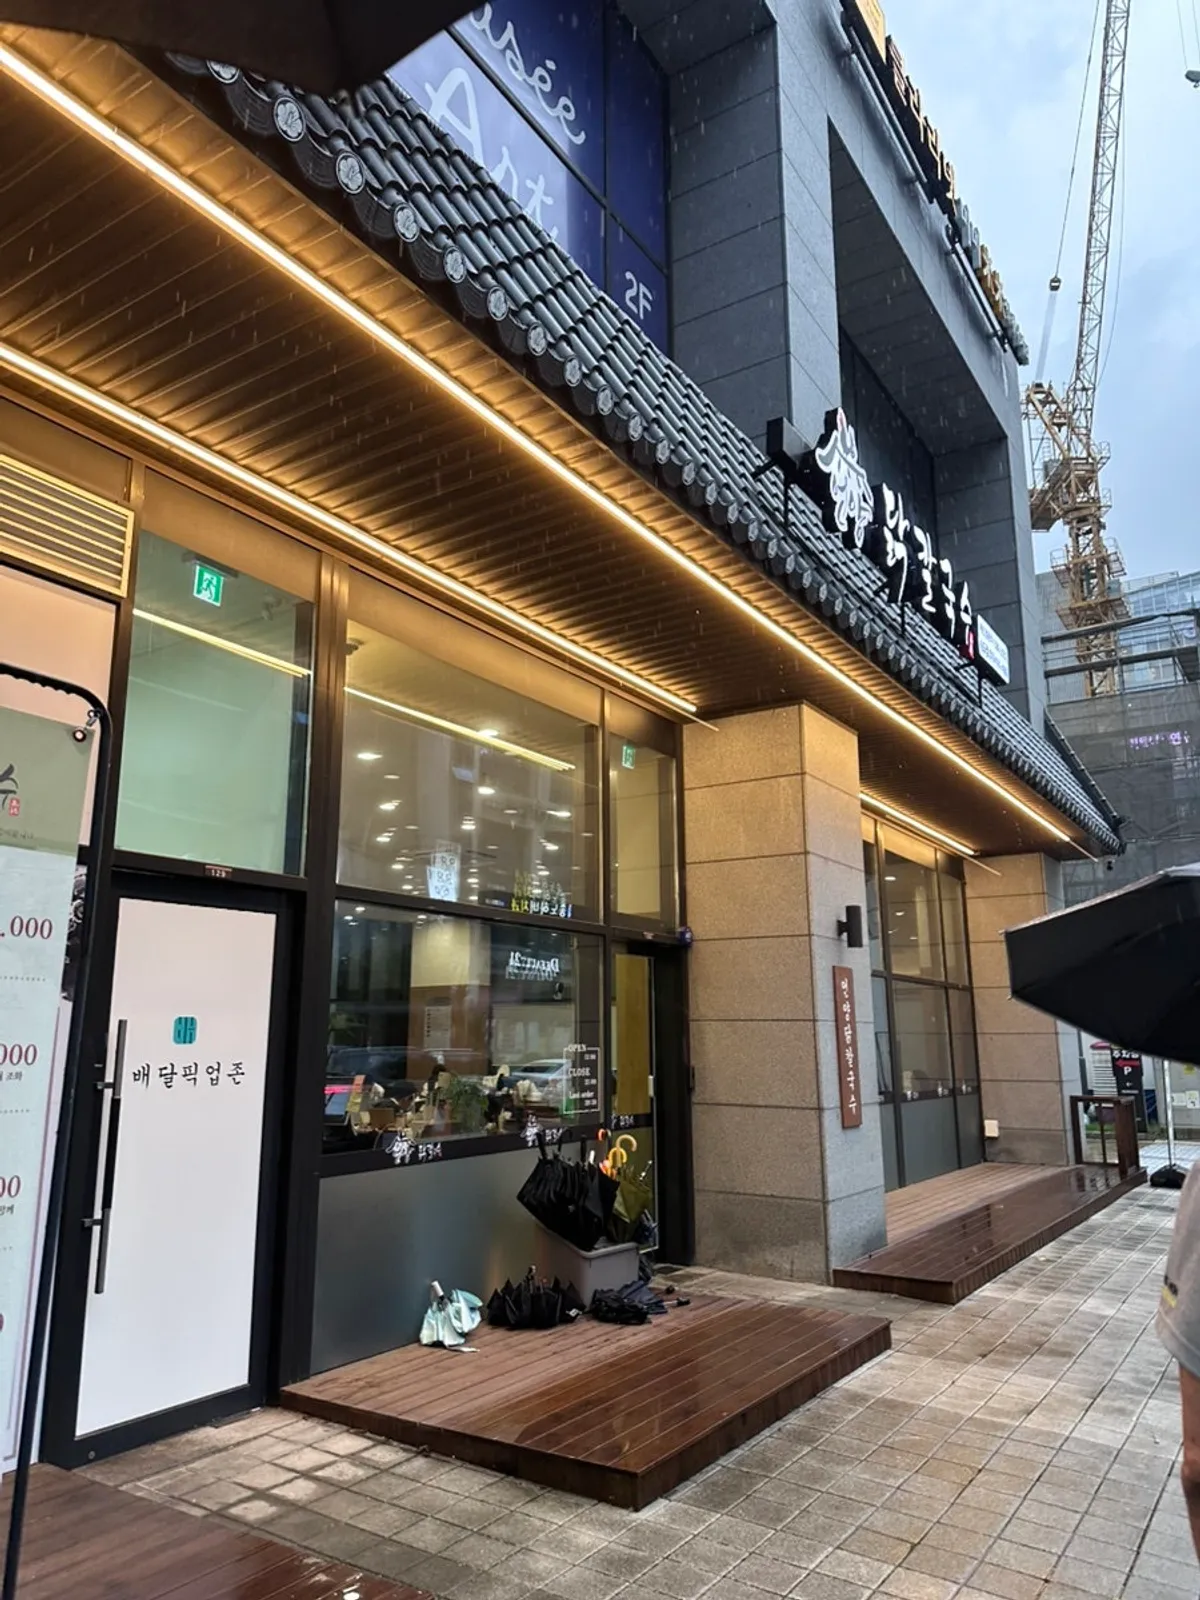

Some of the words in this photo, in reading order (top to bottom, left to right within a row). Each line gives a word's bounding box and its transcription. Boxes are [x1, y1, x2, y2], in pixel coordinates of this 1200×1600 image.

[624, 271, 653, 320] 2F
[568, 1044, 586, 1052] OPEN
[132, 1061, 245, 1090] 배달픽업존
[568, 1067, 591, 1077] CLOSE
[1124, 1066, 1132, 1076] P
